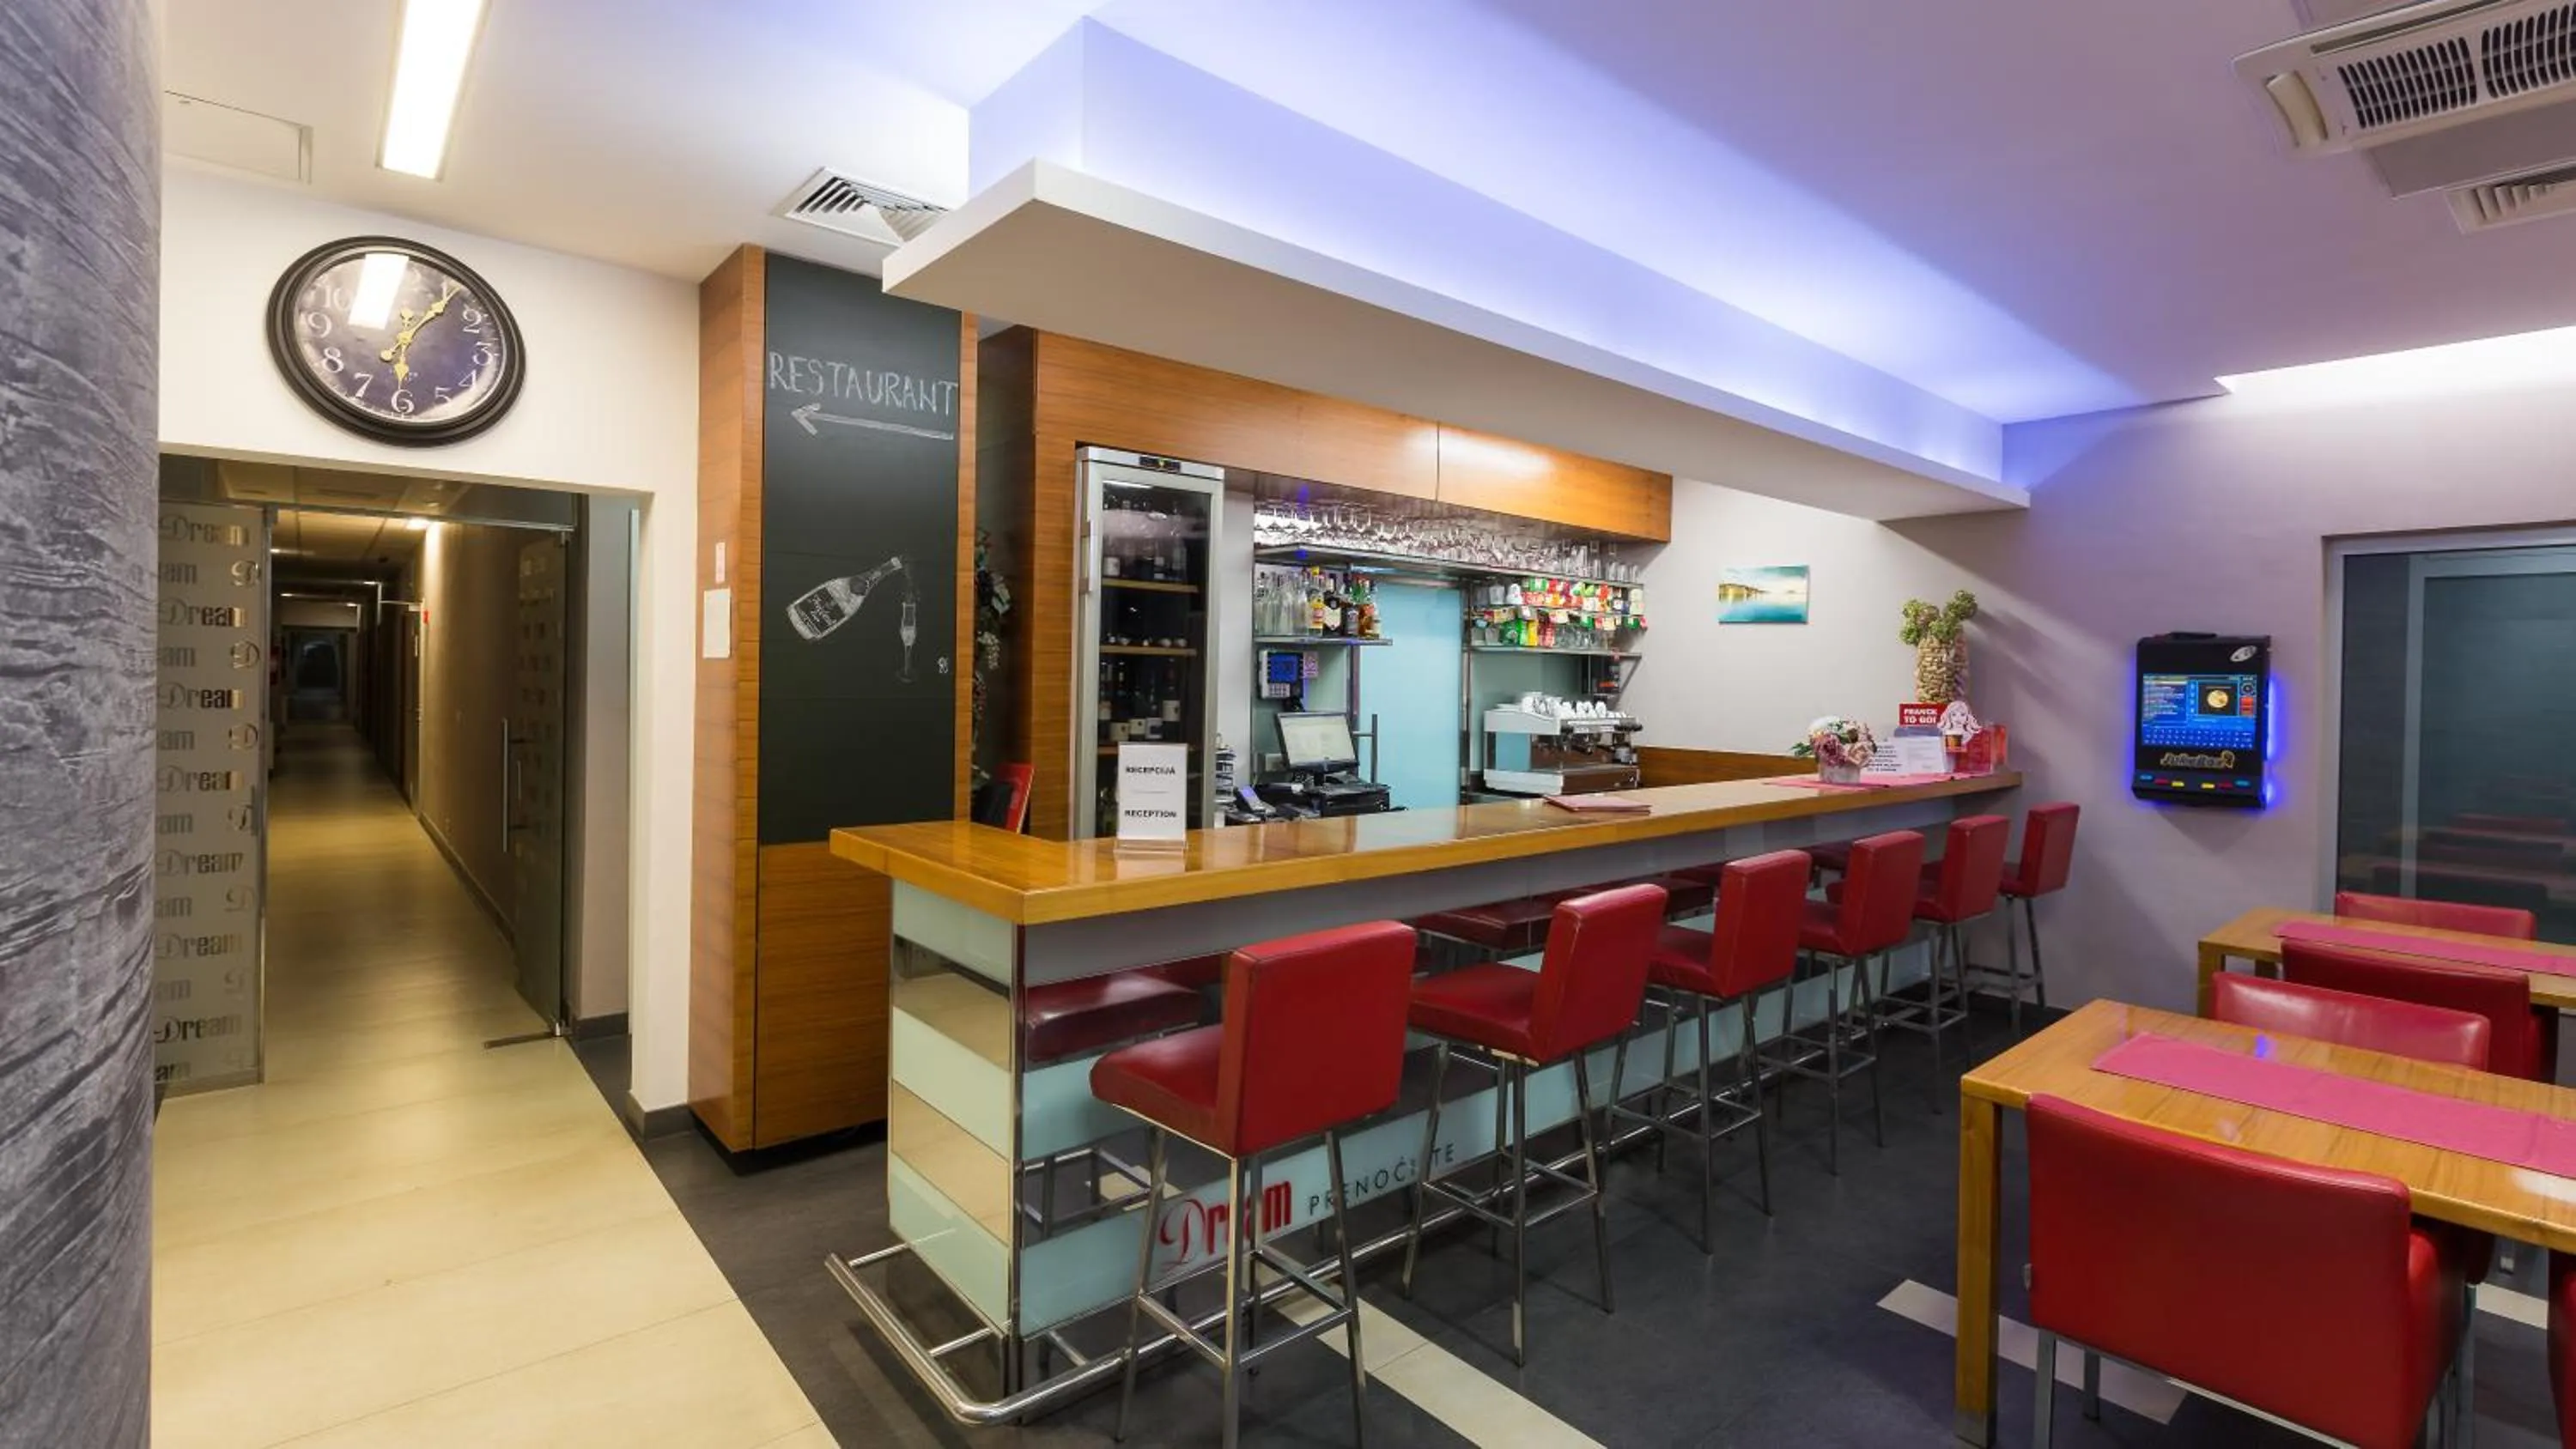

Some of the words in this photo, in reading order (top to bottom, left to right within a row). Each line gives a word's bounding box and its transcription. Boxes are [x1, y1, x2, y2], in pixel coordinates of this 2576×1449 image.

[307, 310, 332, 338] 9
[461, 308, 483, 334] 2
[321, 346, 344, 373] 8
[472, 341, 494, 367] 3
[353, 373, 374, 398] 7
[459, 369, 477, 392] 4
[769, 351, 959, 416] RESTAURANT
[391, 388, 416, 415] 6
[1903, 715, 1917, 724] TO
[1126, 766, 1176, 775] RECEPCIJA
[1124, 809, 1177, 818] RECEPTION
[155, 848, 244, 877] Dream
[154, 1013, 242, 1044] Dream
[1159, 1180, 1292, 1264] Drm
[1309, 1143, 1455, 1216] PRENOĆITE
